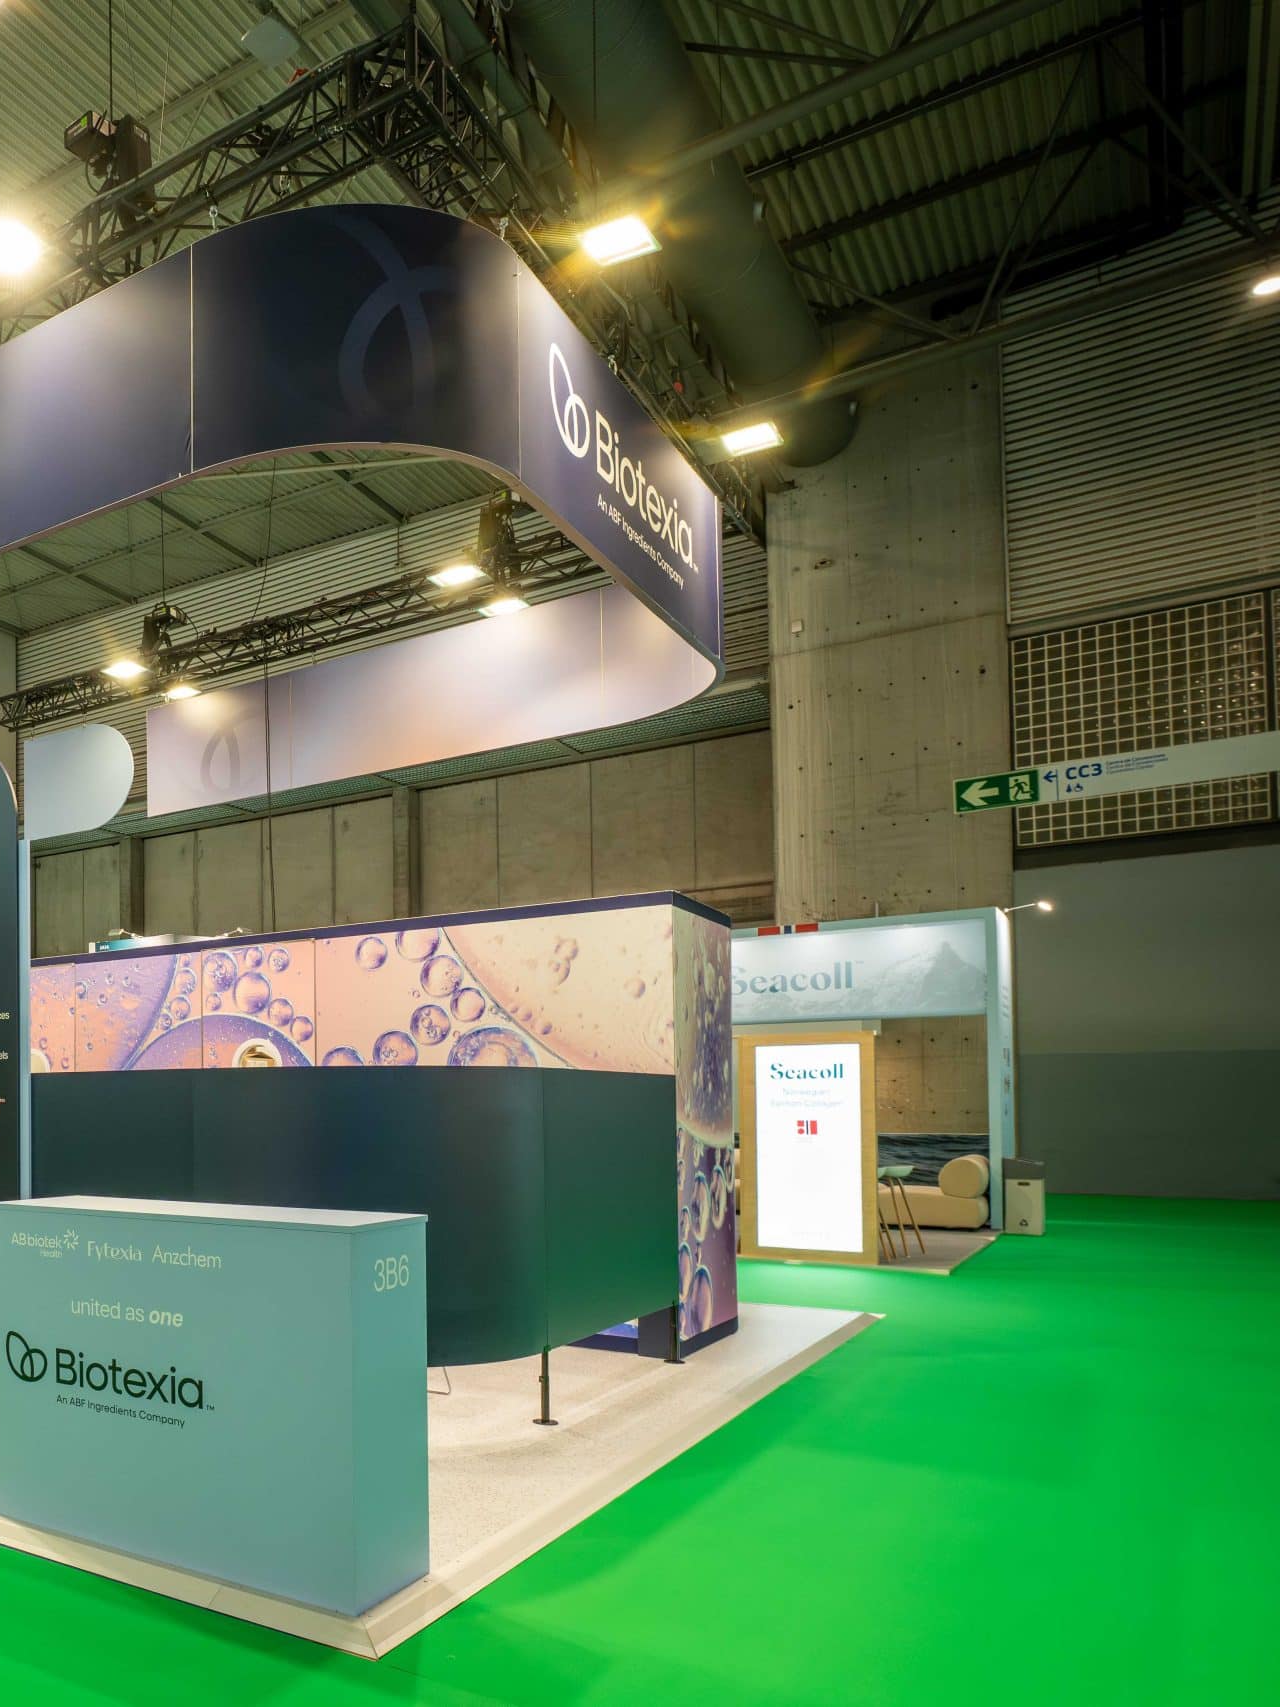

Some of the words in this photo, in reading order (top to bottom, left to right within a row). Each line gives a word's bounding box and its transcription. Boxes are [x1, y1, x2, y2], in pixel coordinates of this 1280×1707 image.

[596, 410, 693, 569] Biotexia
[598, 493, 608, 514] An
[609, 504, 621, 526] ABF
[623, 517, 656, 561] Ingredients
[657, 552, 684, 590] Company
[1066, 763, 1102, 780] CC3
[731, 960, 853, 996] Seacoll
[771, 1063, 844, 1080] Seacoll
[40, 1249, 63, 1259] Health
[152, 1244, 222, 1270] Anzchem
[374, 1254, 410, 1292] 3B6
[71, 1299, 121, 1320] united
[125, 1306, 145, 1323] as
[149, 1309, 184, 1328] one
[56, 1348, 204, 1410] Biotexia
[56, 1394, 68, 1405] An
[70, 1396, 86, 1408] ABF
[87, 1399, 137, 1419] Ingredients
[138, 1411, 186, 1429] Company
